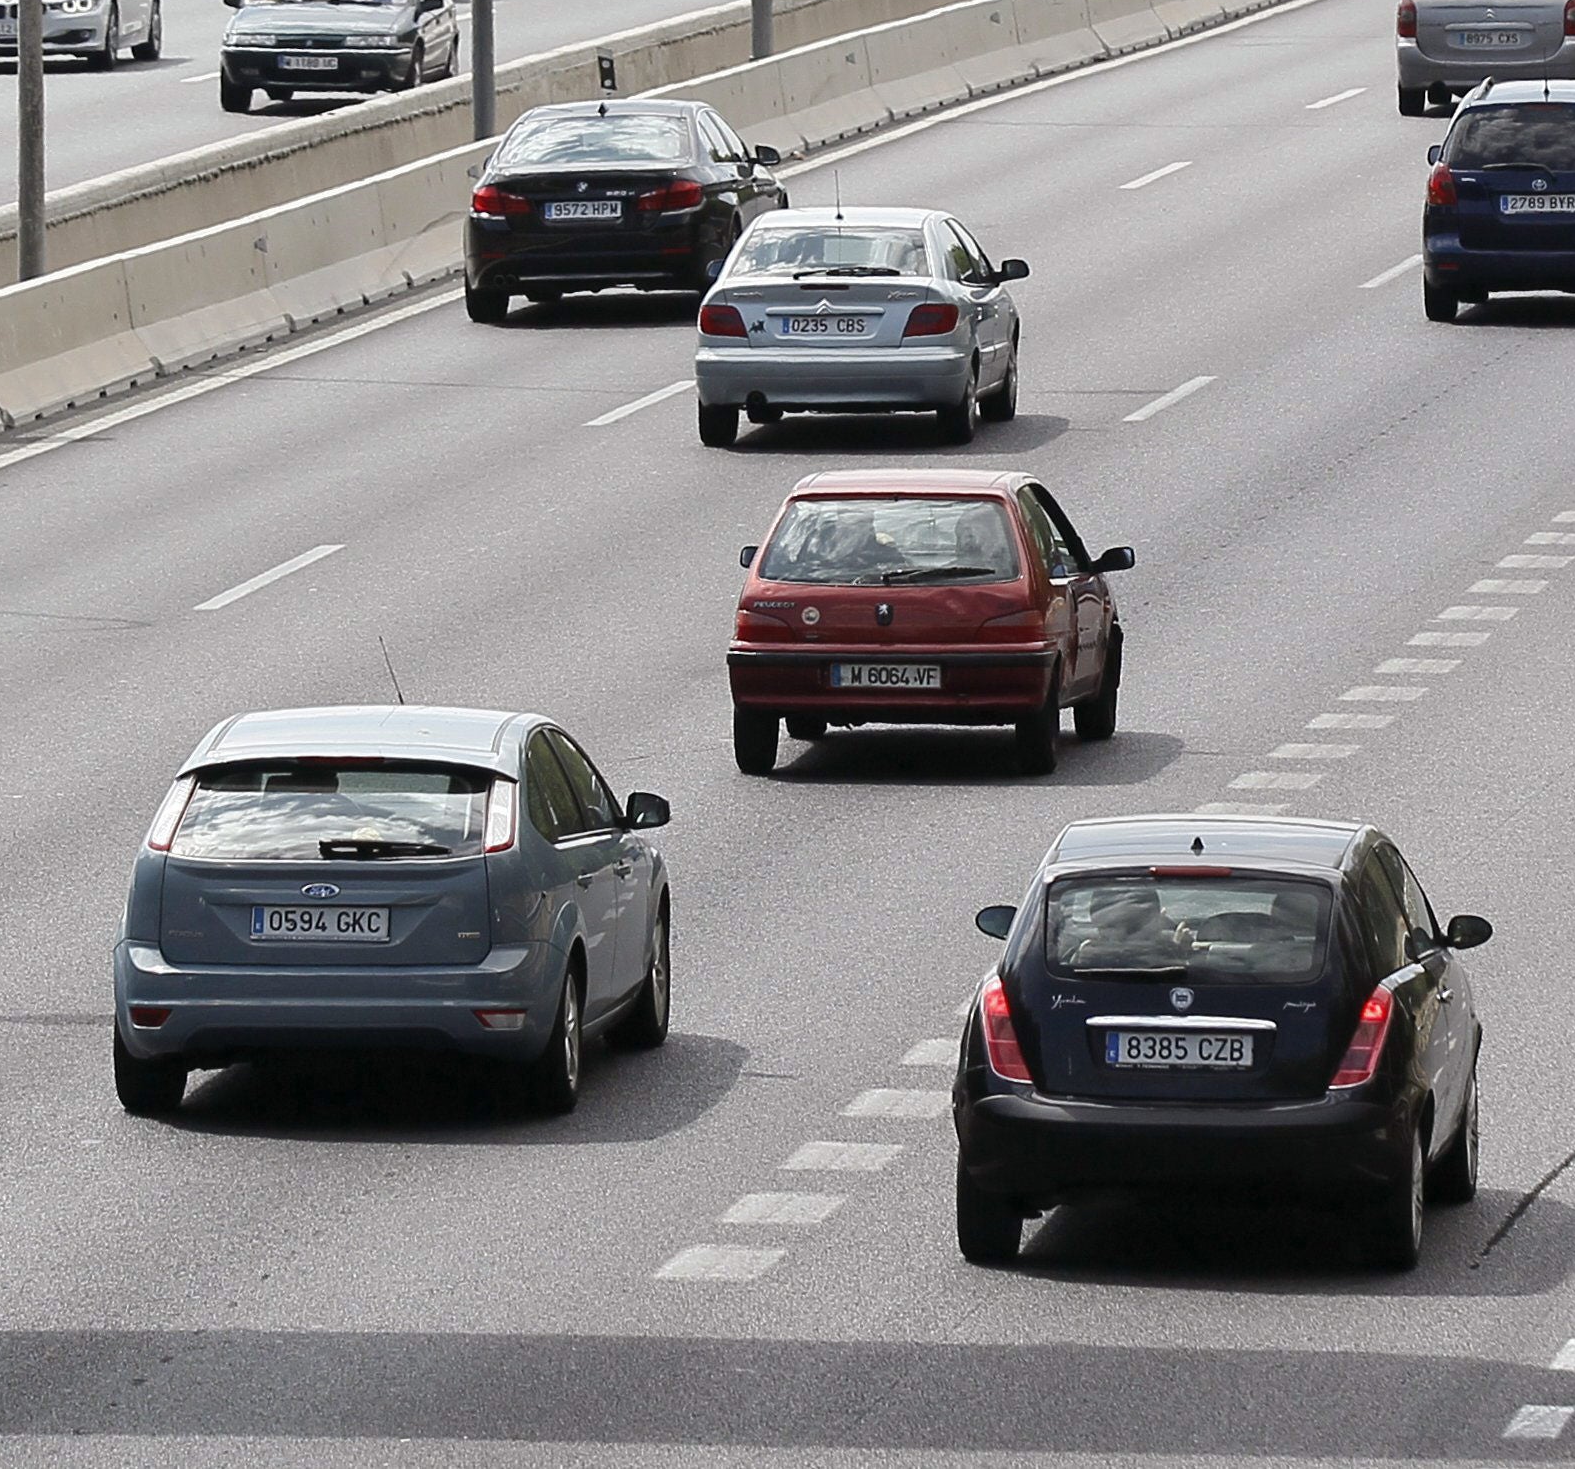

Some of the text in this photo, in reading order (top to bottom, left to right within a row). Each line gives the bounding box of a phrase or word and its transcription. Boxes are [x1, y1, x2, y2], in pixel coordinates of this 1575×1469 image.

[554, 200, 619, 216] 9572 HPM
[1510, 196, 1575, 210] 2789 BYR
[792, 318, 865, 333] 0235 CBS
[851, 667, 937, 684] M 6064 VF
[269, 910, 381, 933] 0594 GKC
[1126, 1036, 1244, 1061] 8385 CZB
